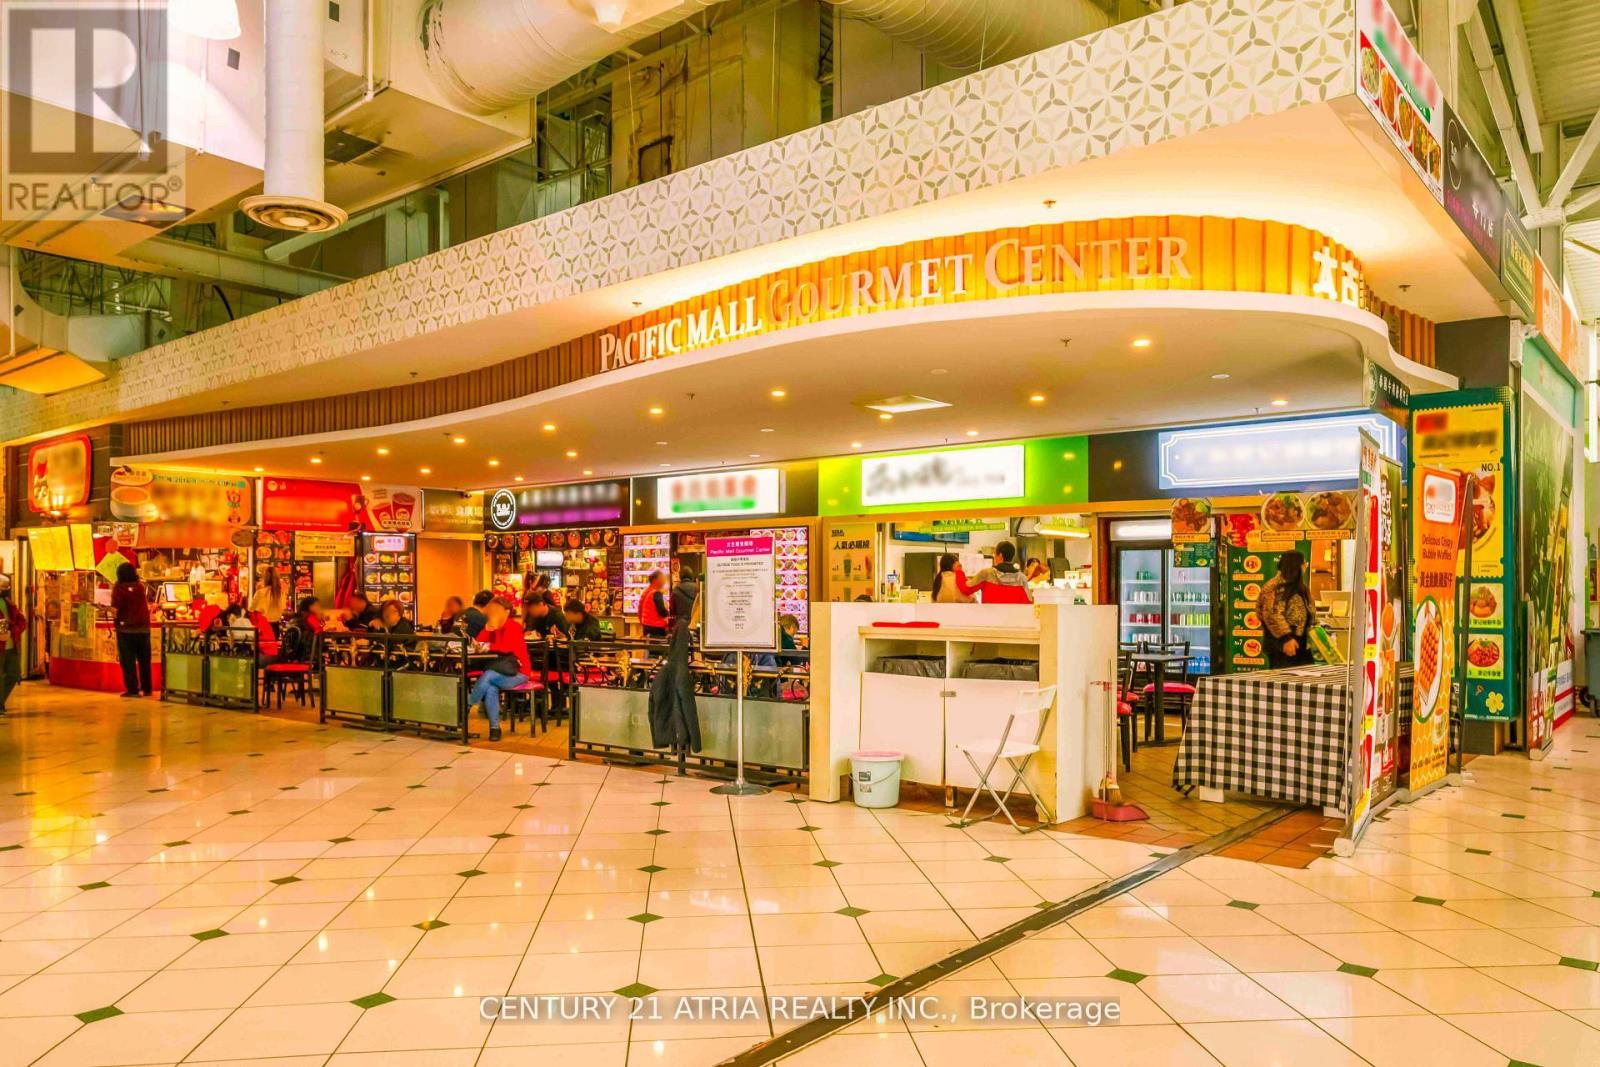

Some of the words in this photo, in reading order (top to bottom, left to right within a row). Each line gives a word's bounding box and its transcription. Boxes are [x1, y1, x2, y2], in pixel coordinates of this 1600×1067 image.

[600, 318, 682, 372] PACIFIC
[687, 296, 763, 348] MALL
[768, 253, 973, 325] GOURMET
[984, 236, 1192, 290] CENTER
[1313, 246, 1365, 310] 太古
